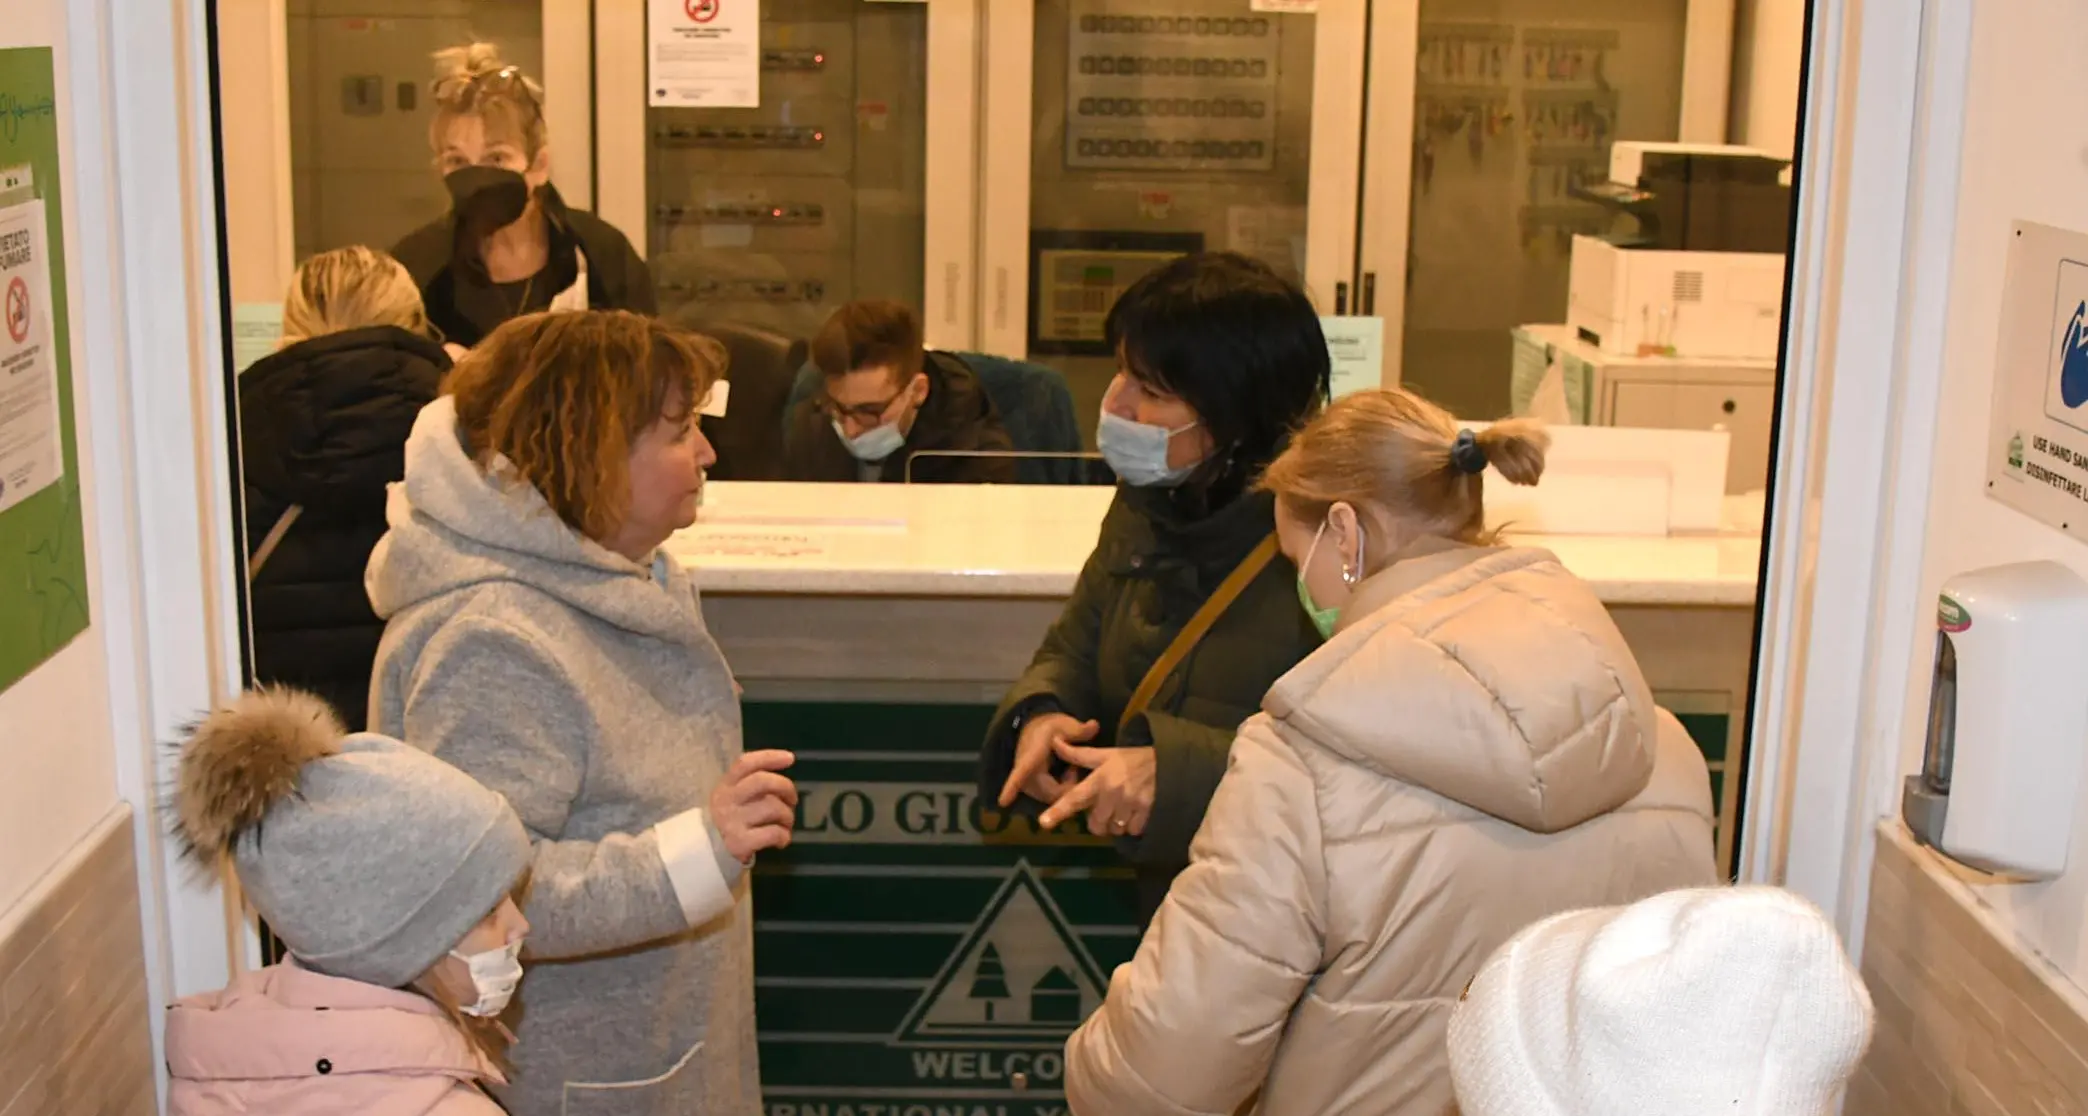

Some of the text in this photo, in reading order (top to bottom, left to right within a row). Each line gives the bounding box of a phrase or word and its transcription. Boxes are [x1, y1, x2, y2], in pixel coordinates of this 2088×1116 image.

[0, 228, 30, 253] IETATO
[2033, 434, 2047, 453] USE
[2048, 442, 2072, 463] HAND
[2026, 461, 2082, 499] DISINFETTARE
